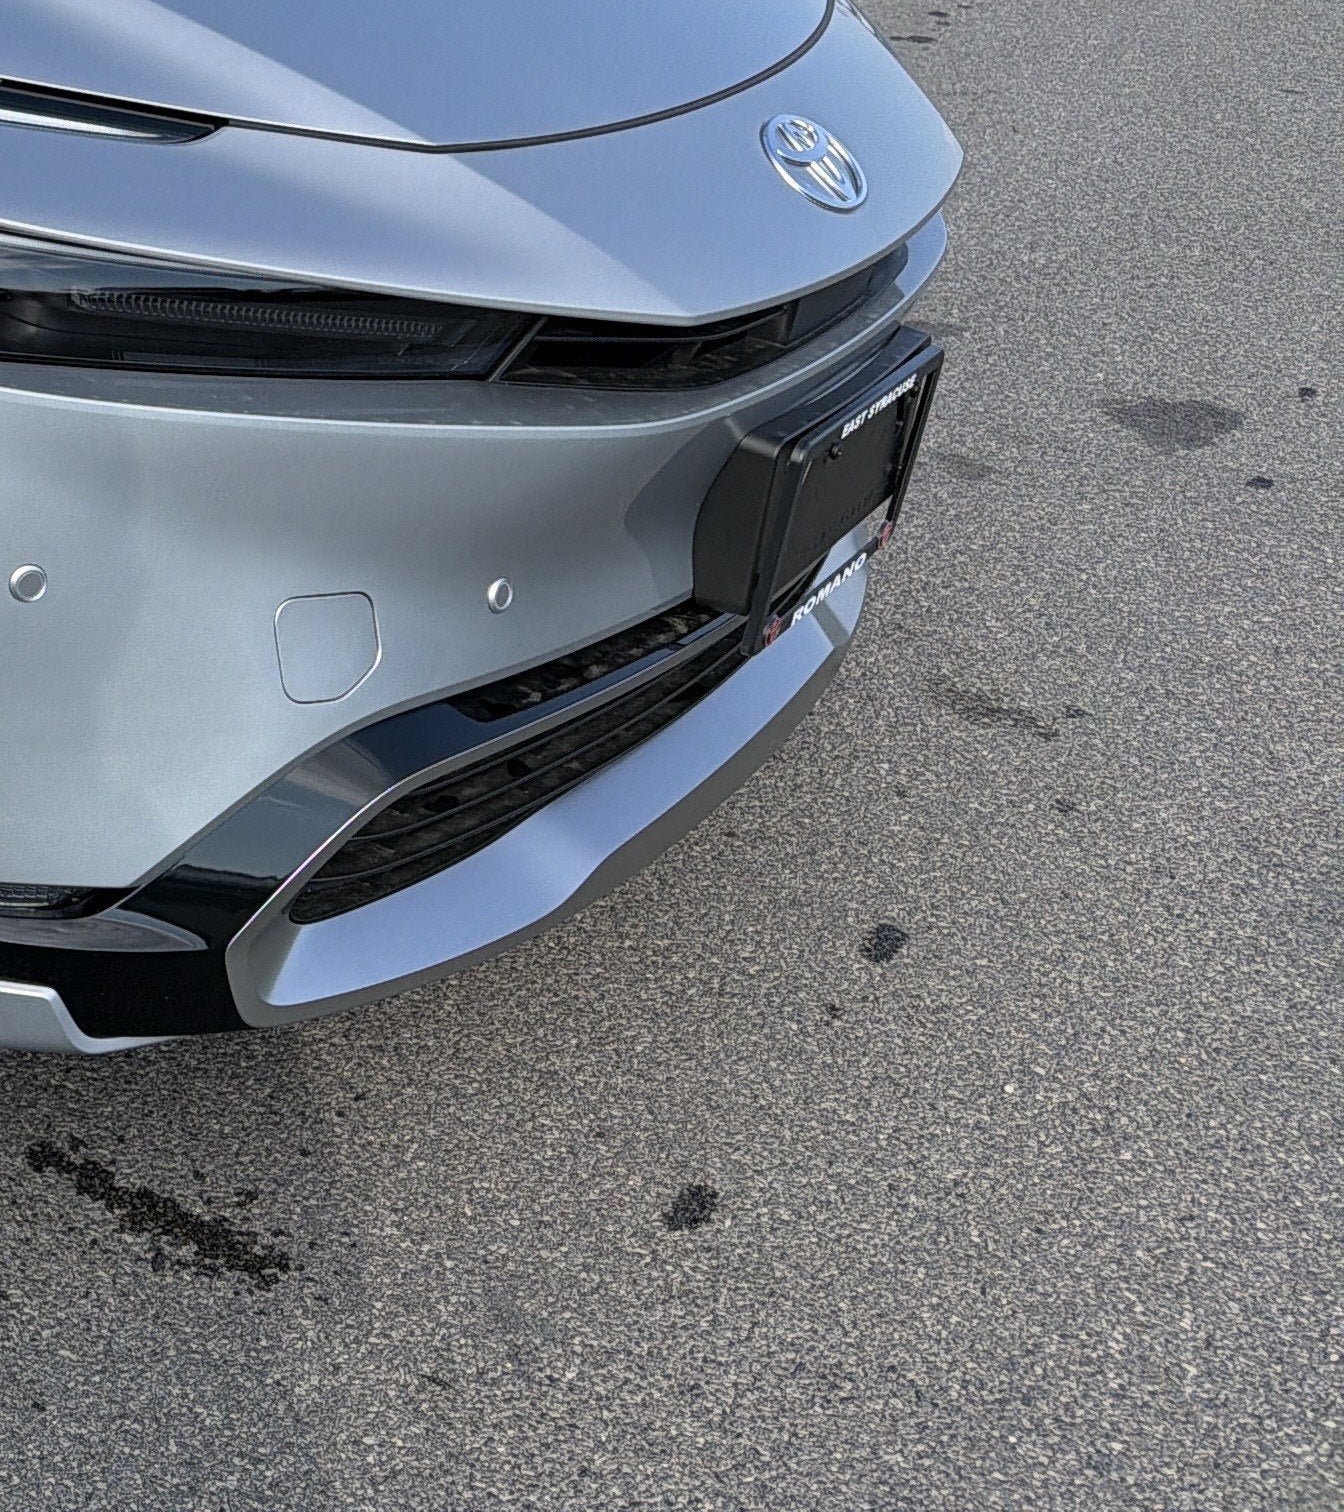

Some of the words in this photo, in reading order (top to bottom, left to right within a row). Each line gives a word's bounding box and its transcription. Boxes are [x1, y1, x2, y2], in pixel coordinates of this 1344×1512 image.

[841, 409, 869, 439] EAST
[868, 374, 917, 419] SYRACUSE
[791, 552, 867, 627] ROMANO
